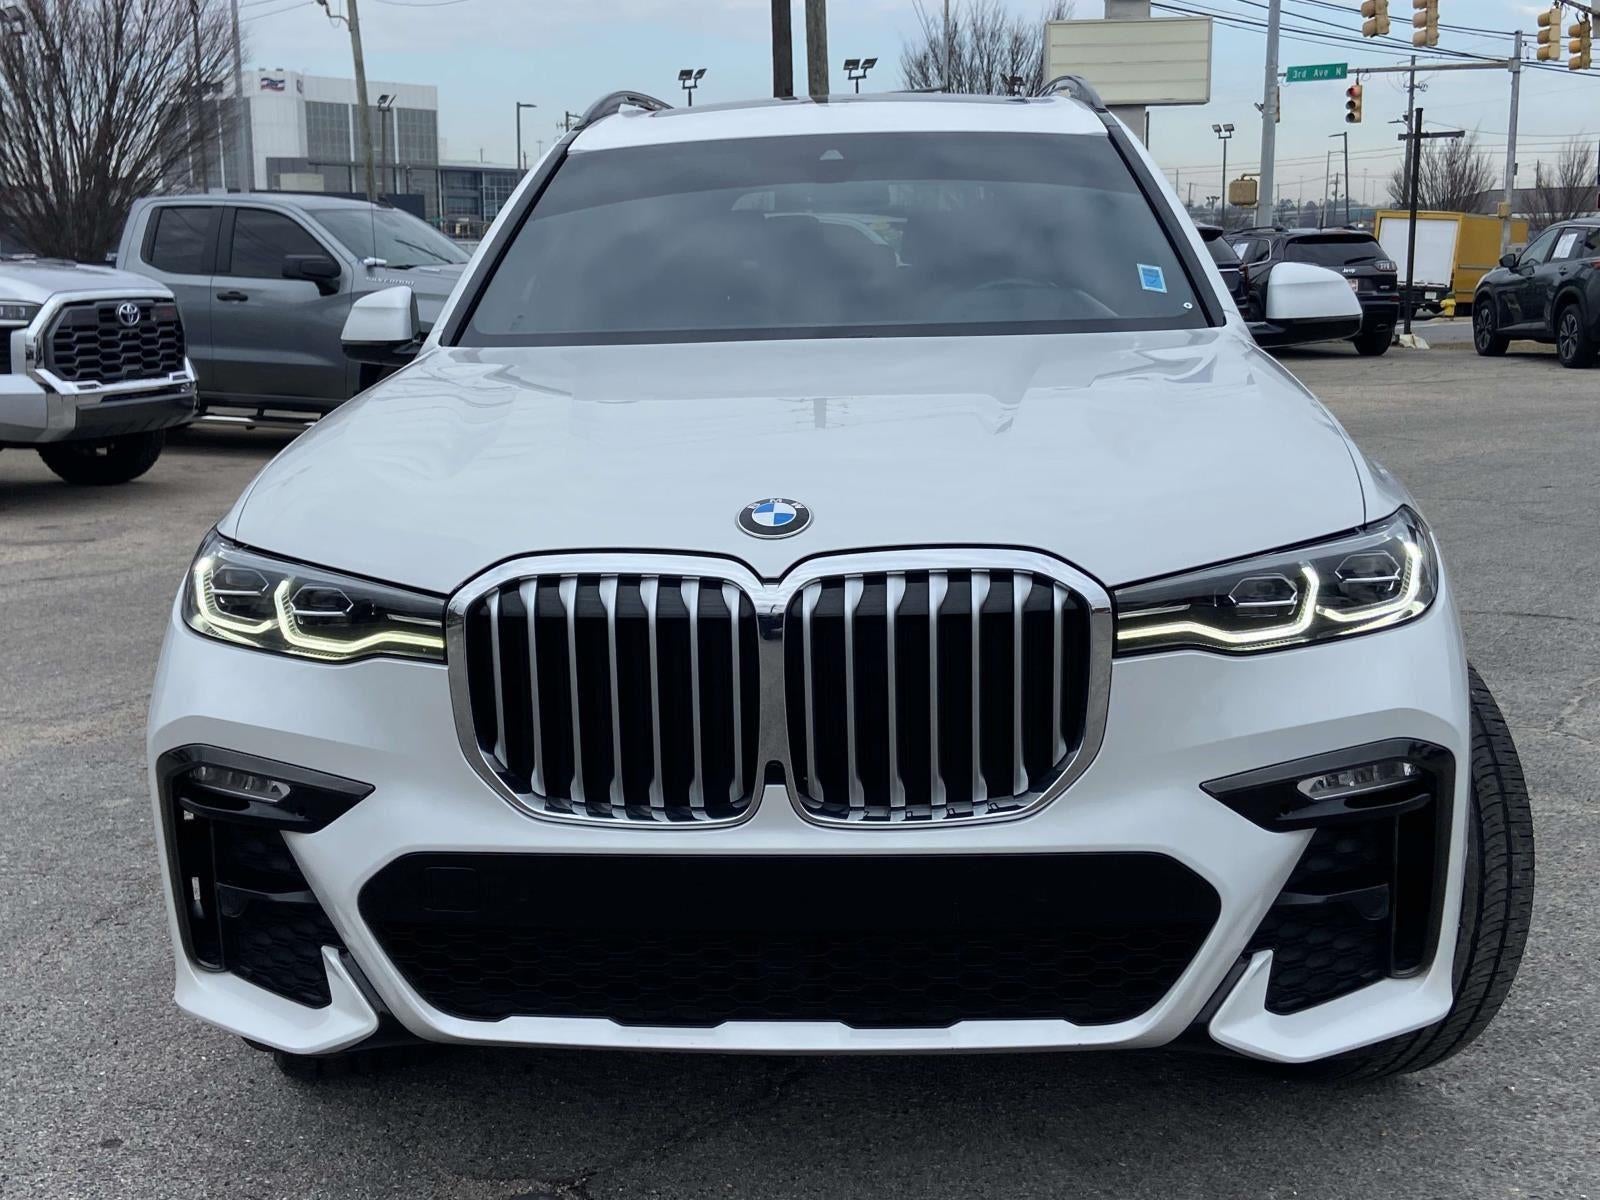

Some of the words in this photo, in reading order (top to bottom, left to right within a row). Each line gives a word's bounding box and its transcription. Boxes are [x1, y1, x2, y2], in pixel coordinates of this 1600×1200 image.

[1292, 69, 1307, 79] 3rd
[1313, 68, 1329, 78] Ave
[1335, 66, 1342, 76] N
